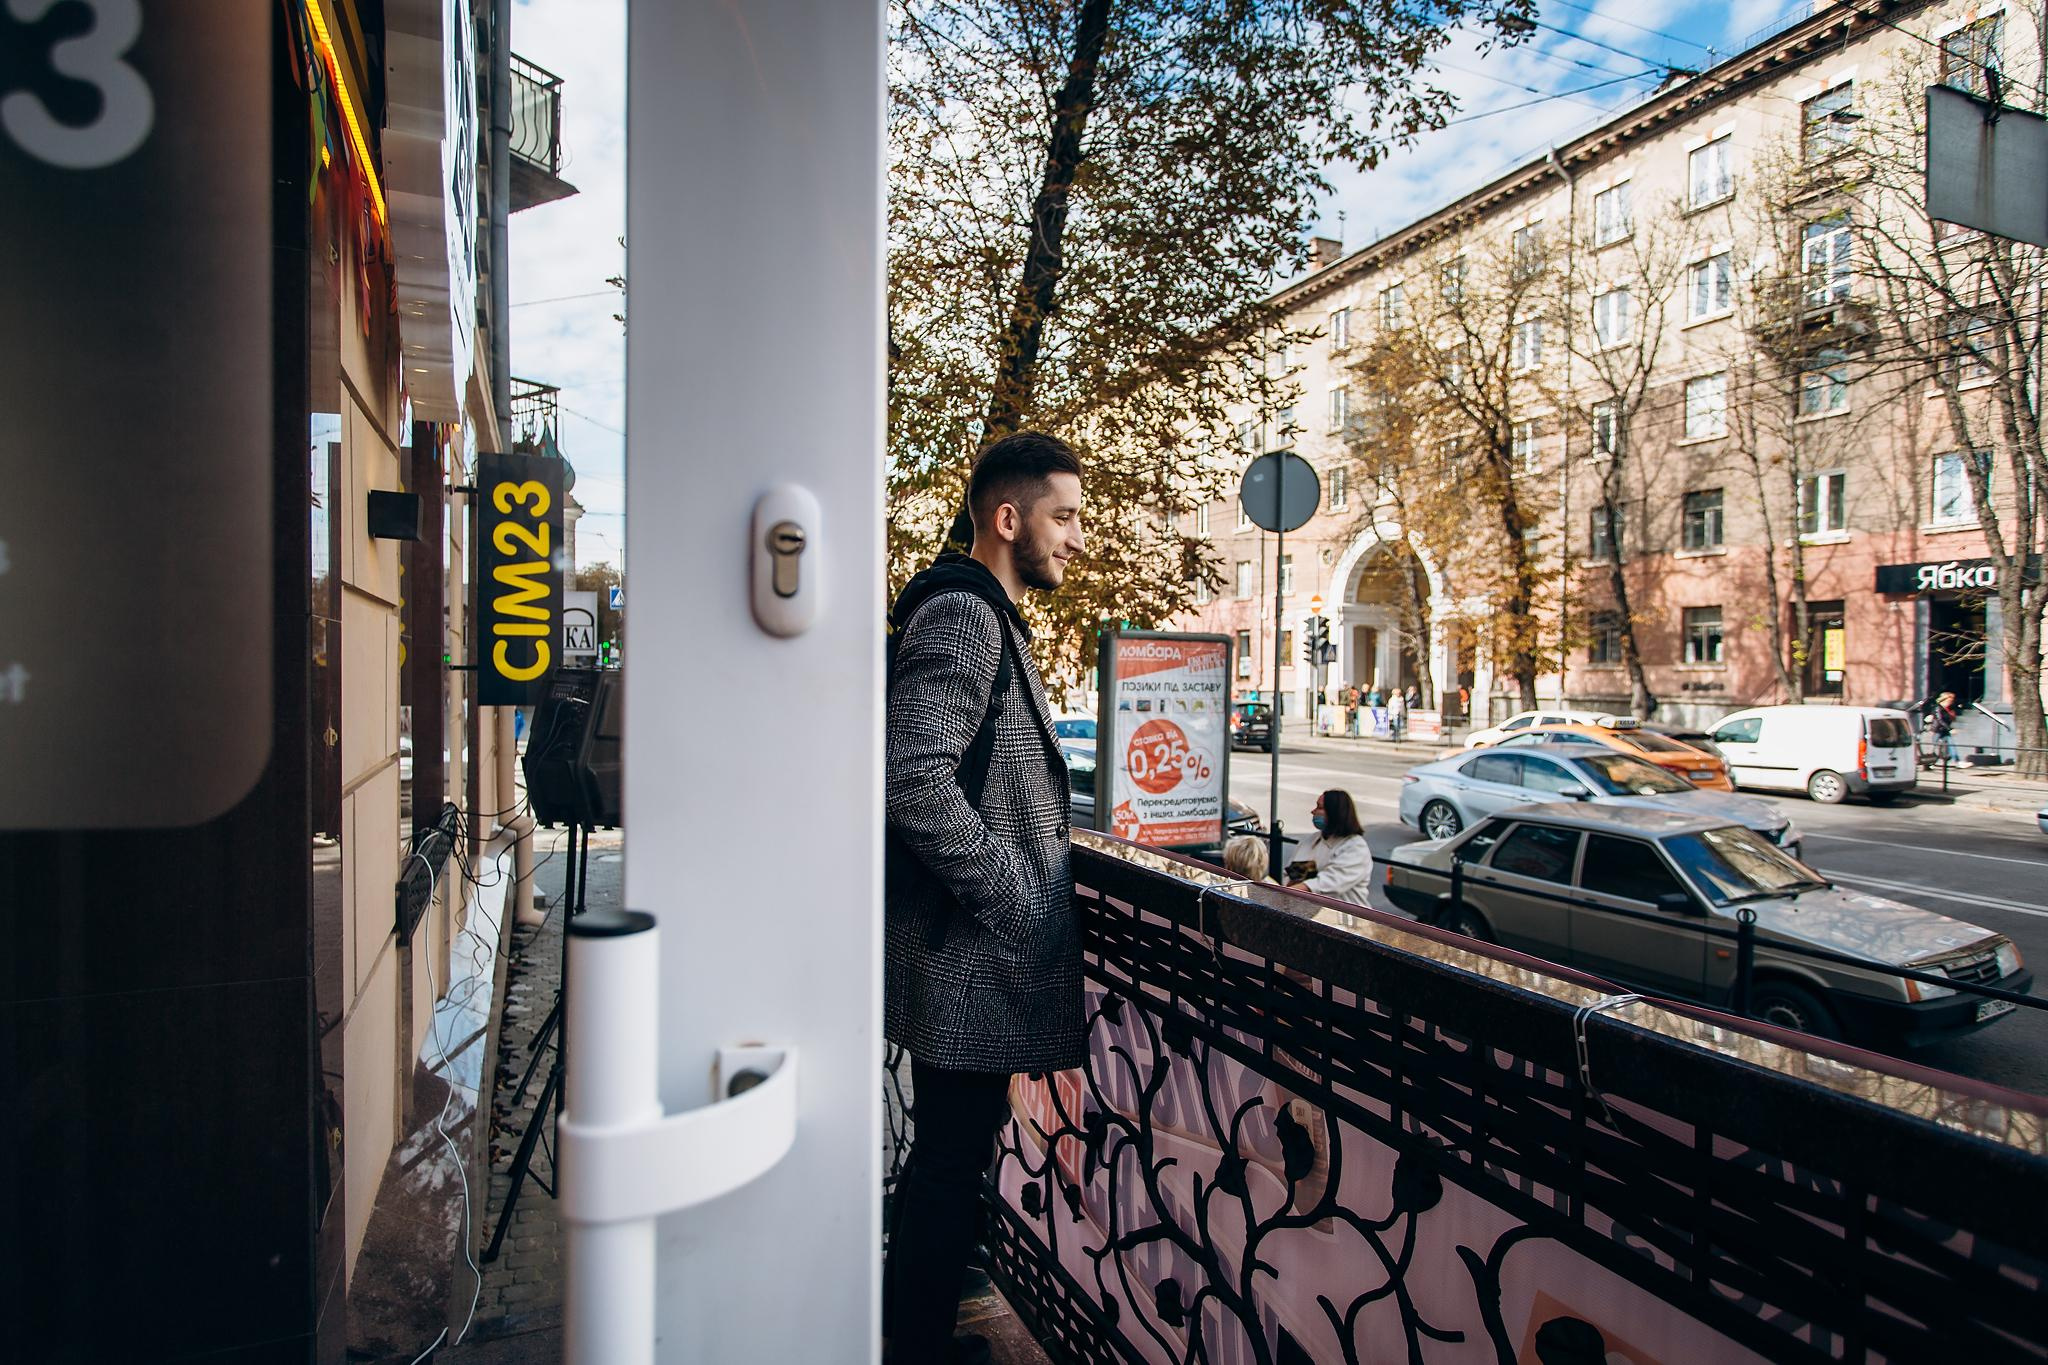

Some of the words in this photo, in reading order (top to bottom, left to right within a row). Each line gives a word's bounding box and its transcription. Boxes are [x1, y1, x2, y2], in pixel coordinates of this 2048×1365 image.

[492, 480, 551, 681] CIM23
[1917, 561, 1996, 590] Ябко
[1119, 642, 1182, 661] ломбард
[1121, 682, 1161, 692] ПОЗИКИ
[1164, 682, 1179, 692] ПІД
[1182, 682, 1222, 692] ЗАСТАВУ
[1137, 795, 1218, 807] Перекредитовуємо
[1176, 807, 1219, 818] ломбардів
